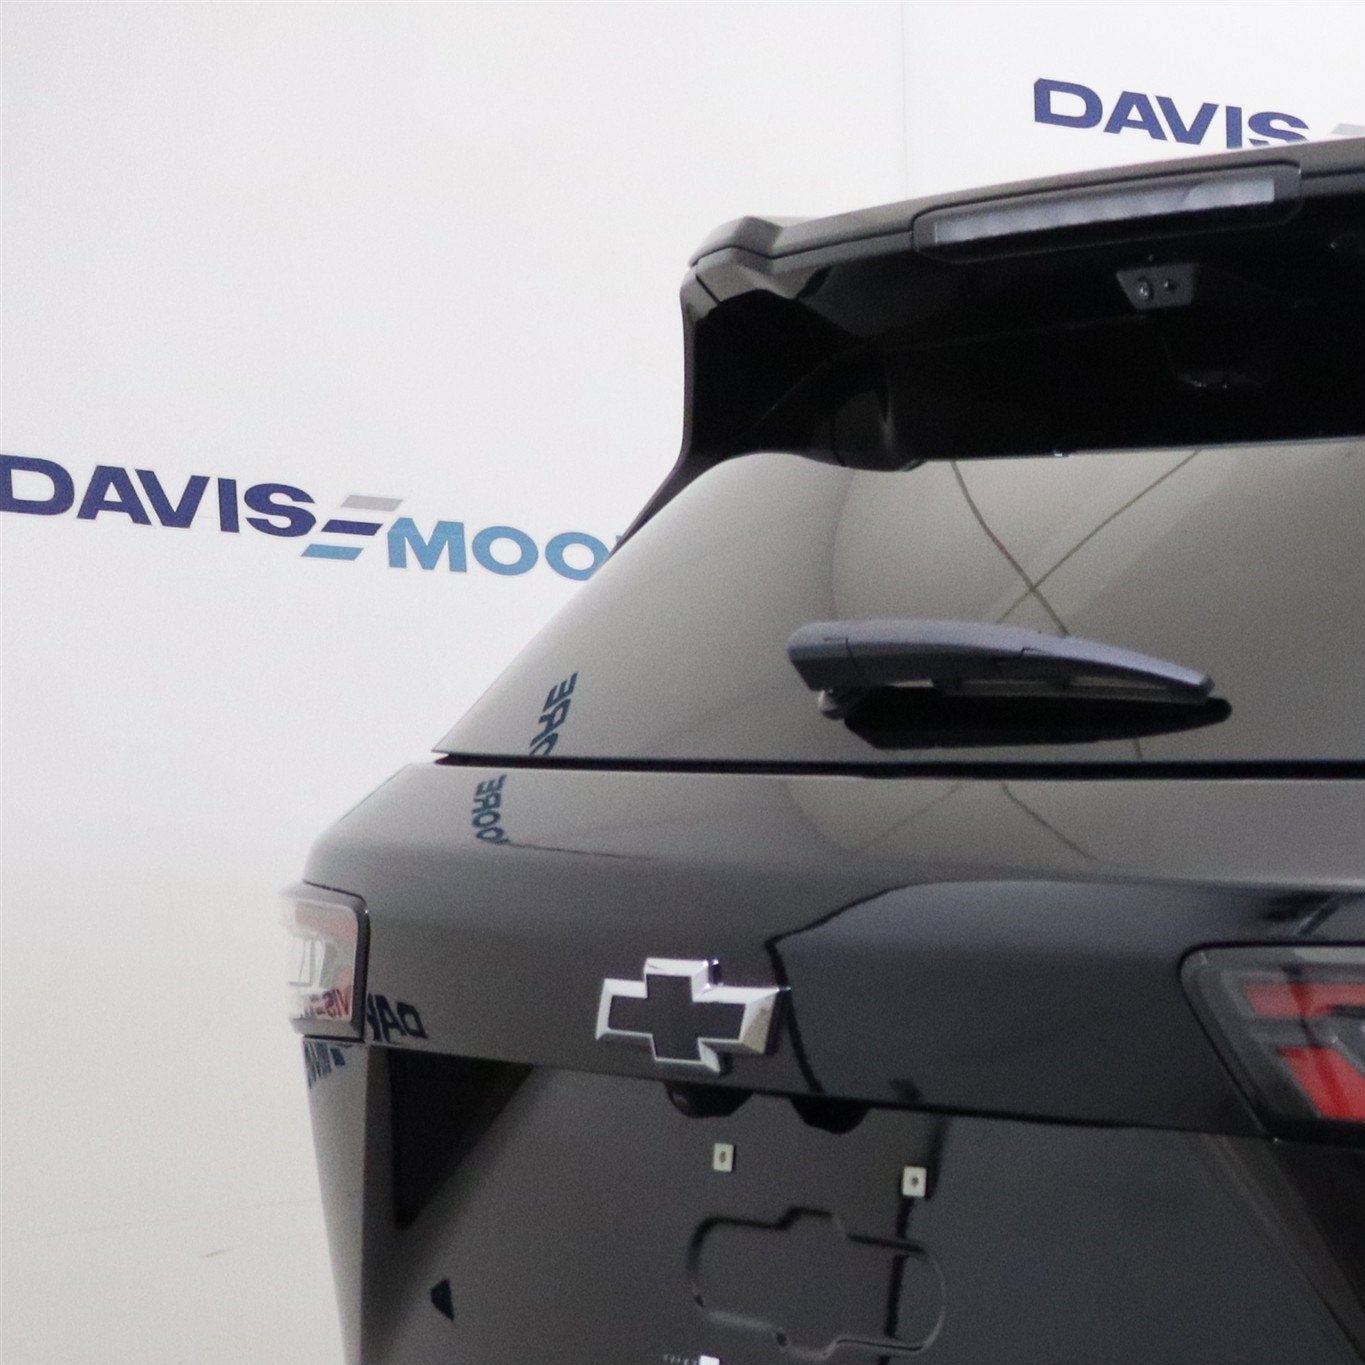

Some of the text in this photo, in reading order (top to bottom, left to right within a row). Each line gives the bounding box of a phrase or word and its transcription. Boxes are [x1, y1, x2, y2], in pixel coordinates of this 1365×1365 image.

[1033, 78, 1310, 149] DAVIS
[0, 453, 623, 581] DAVIS MOO
